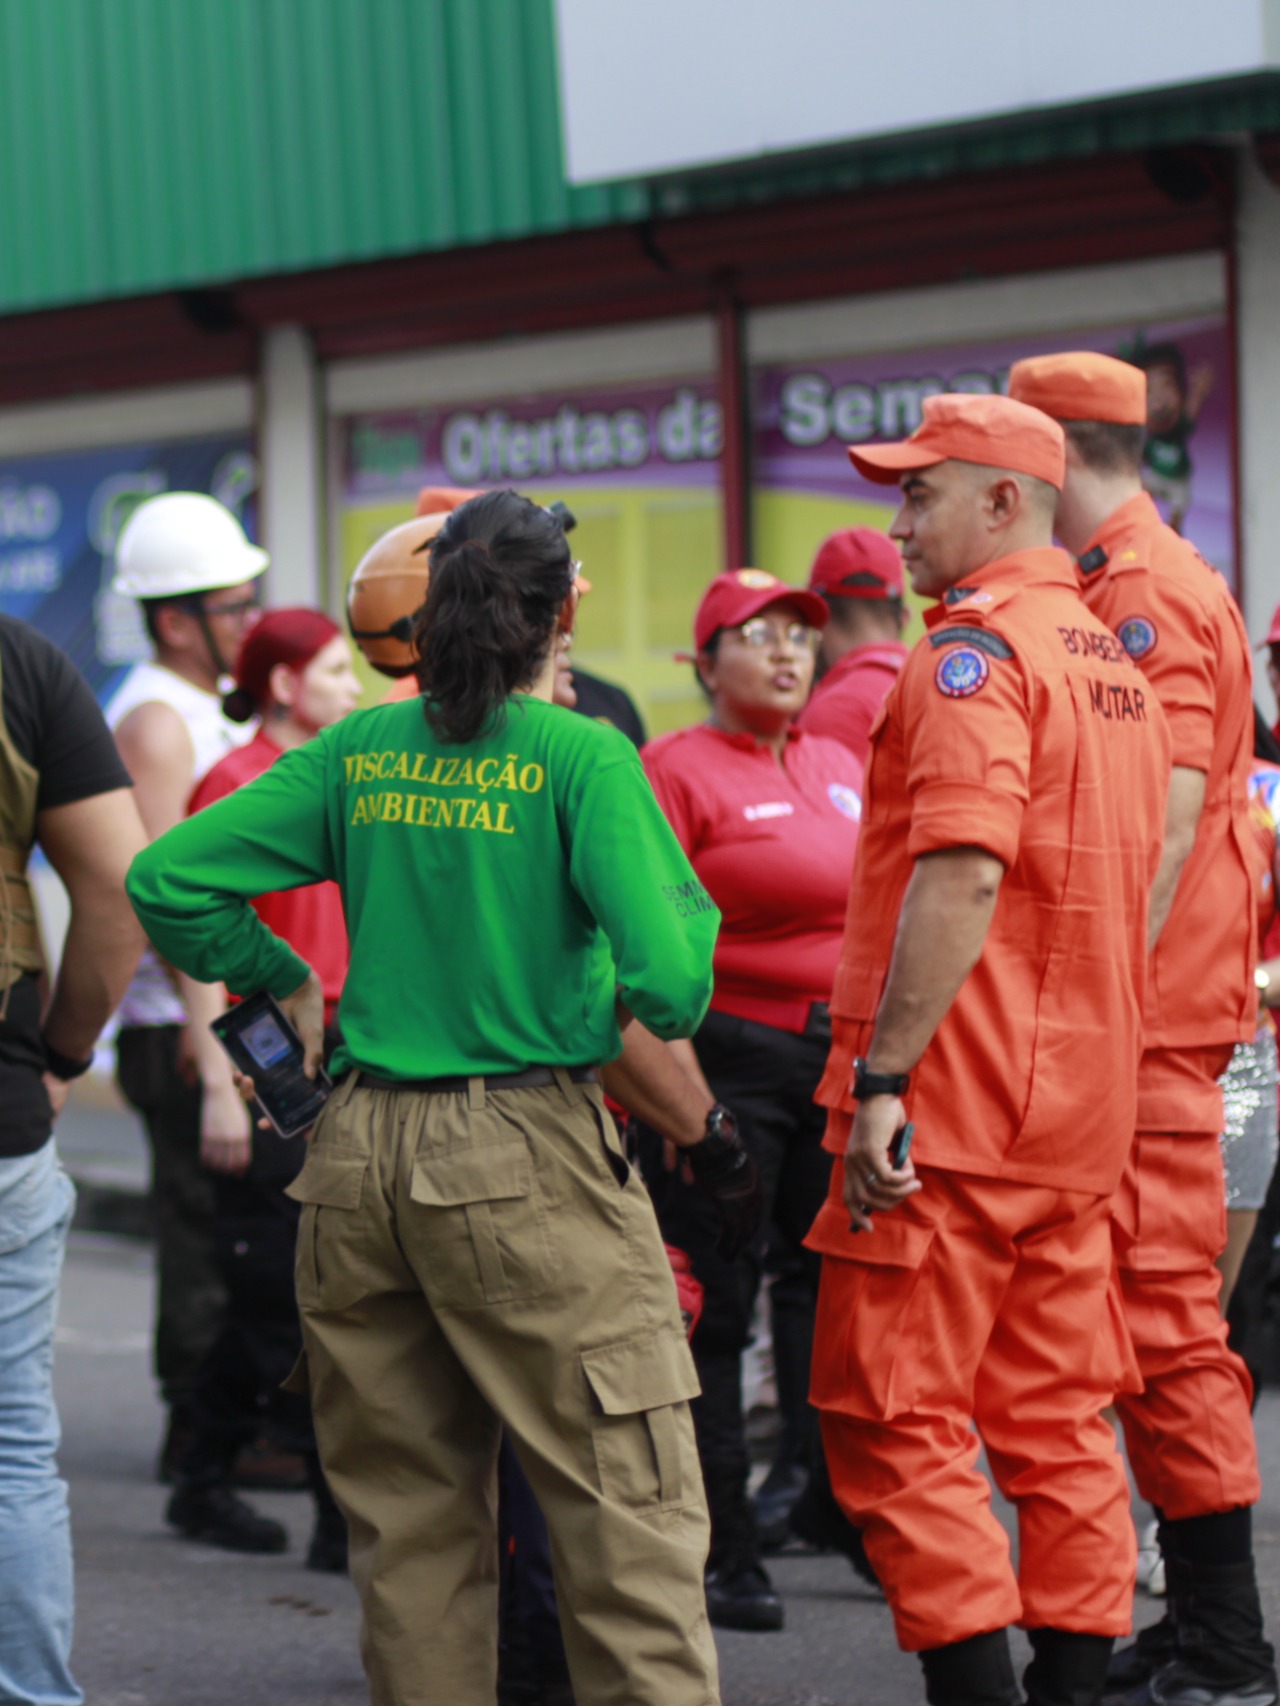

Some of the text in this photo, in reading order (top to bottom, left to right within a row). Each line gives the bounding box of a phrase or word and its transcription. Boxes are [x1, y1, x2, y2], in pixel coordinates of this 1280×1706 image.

[444, 407, 647, 483] Ofertas
[782, 372, 1011, 445] Sem
[351, 792, 515, 834] AMBIENTAL
[676, 896, 715, 918] CLIM
